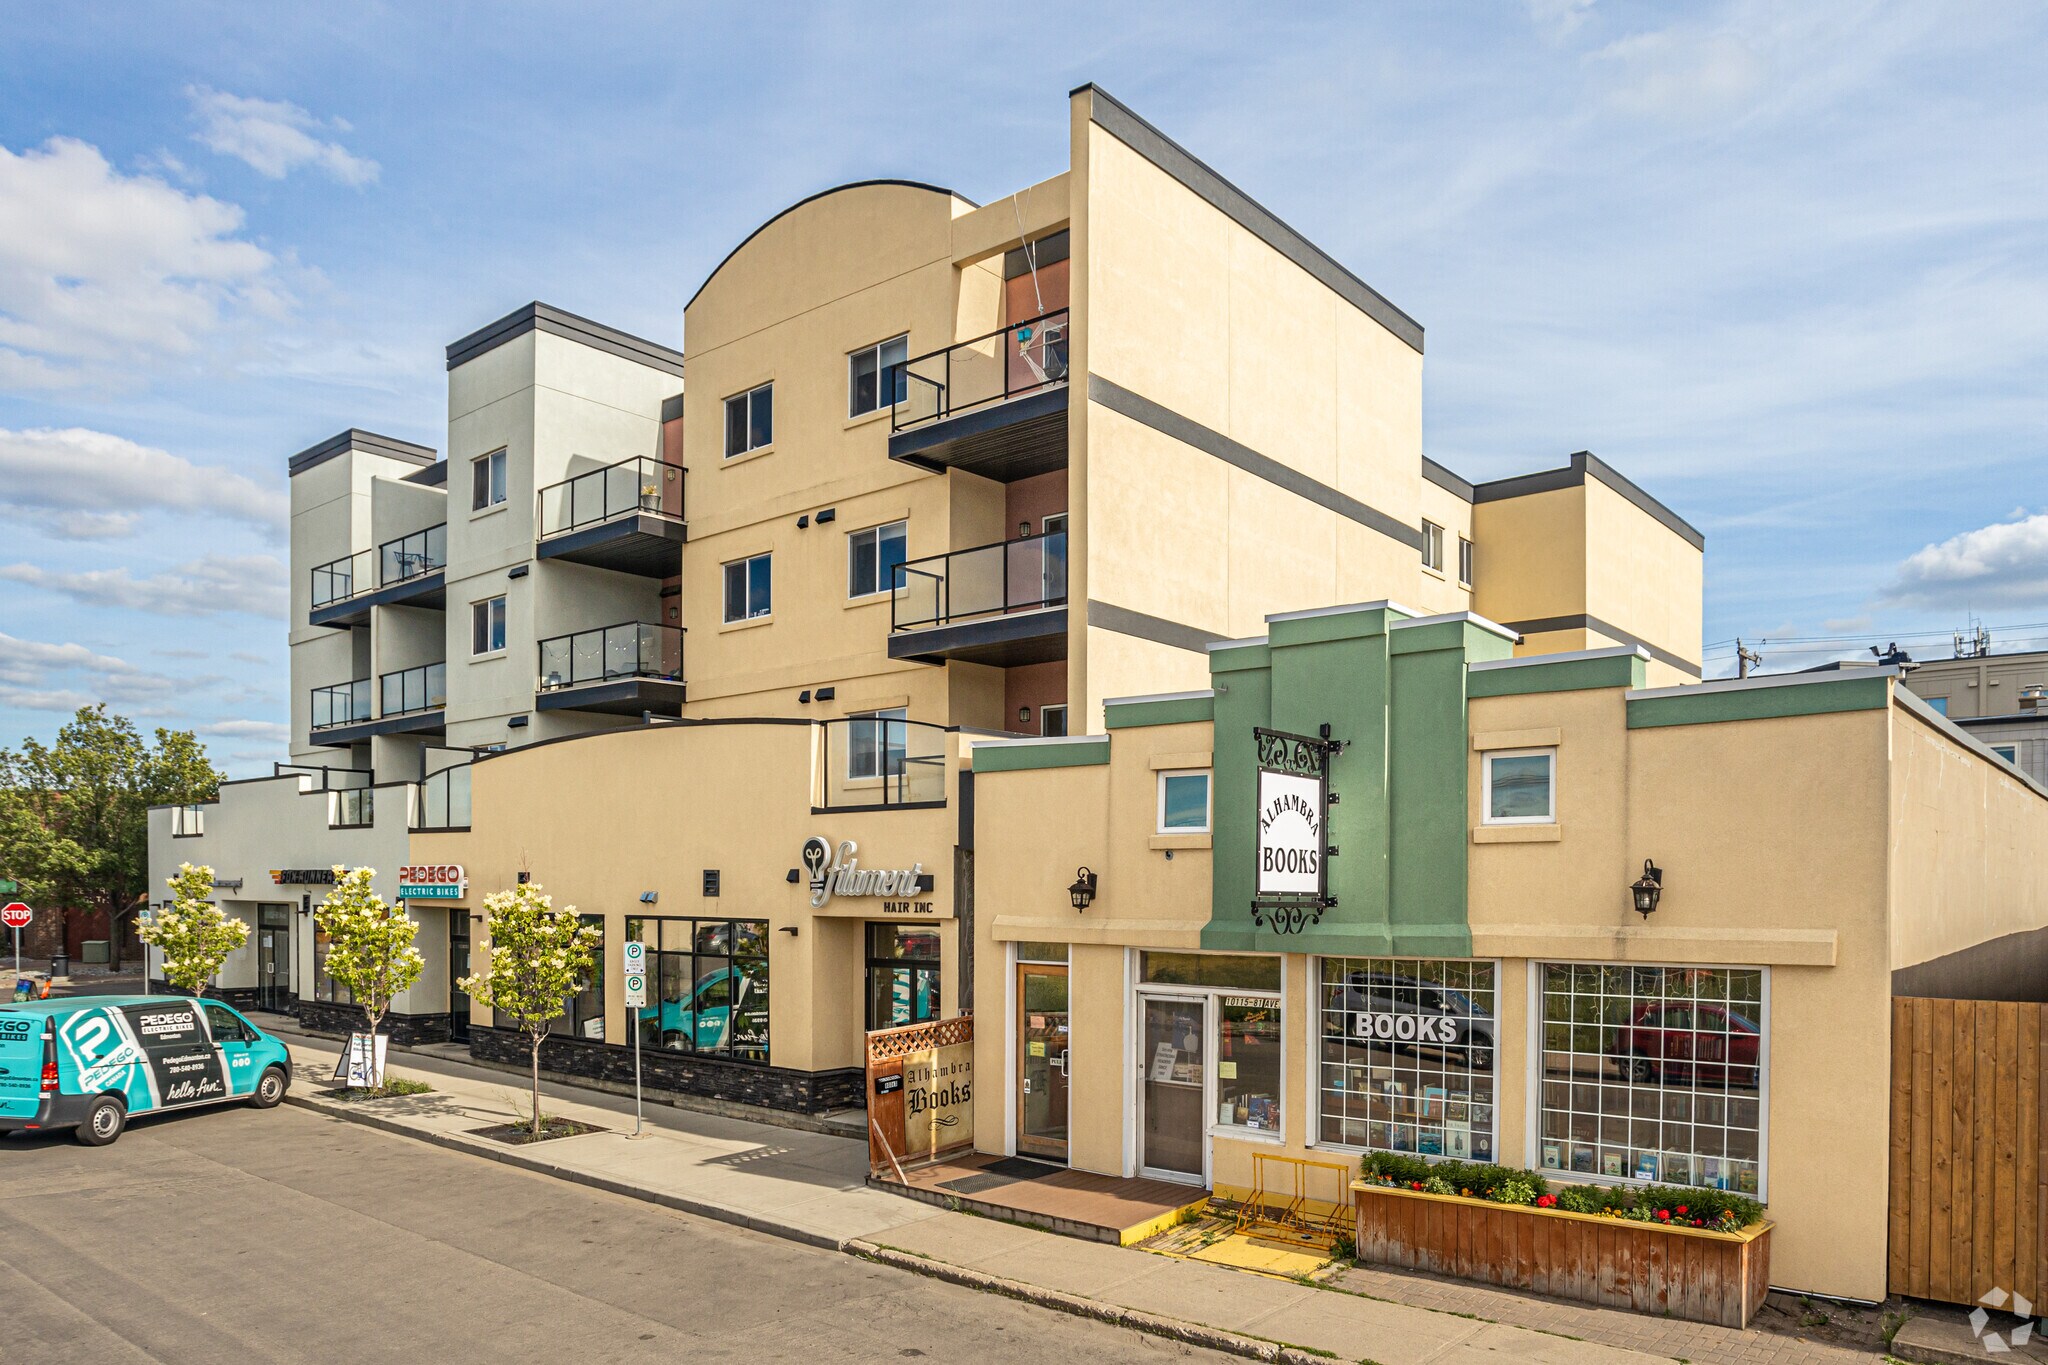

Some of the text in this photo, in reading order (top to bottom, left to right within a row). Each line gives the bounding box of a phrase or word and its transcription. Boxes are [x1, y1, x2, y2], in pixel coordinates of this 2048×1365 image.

[1261, 794, 1319, 837] ALHAMBRA
[1263, 847, 1317, 874] BOOKS
[400, 866, 459, 883] PEDEGO
[401, 886, 458, 895] ELECTRIC BIKES
[3, 910, 31, 920] STOP
[884, 902, 933, 913] HAIR INC
[140, 1013, 193, 1026] PEDEGO
[1356, 1013, 1457, 1042] BOOKS
[143, 1025, 174, 1033] ELECTRIC
[84, 1047, 134, 1086] PEDEGO
[908, 1062, 971, 1084] Alhambra
[105, 1070, 127, 1087] CANADA
[908, 1080, 972, 1120] Books
